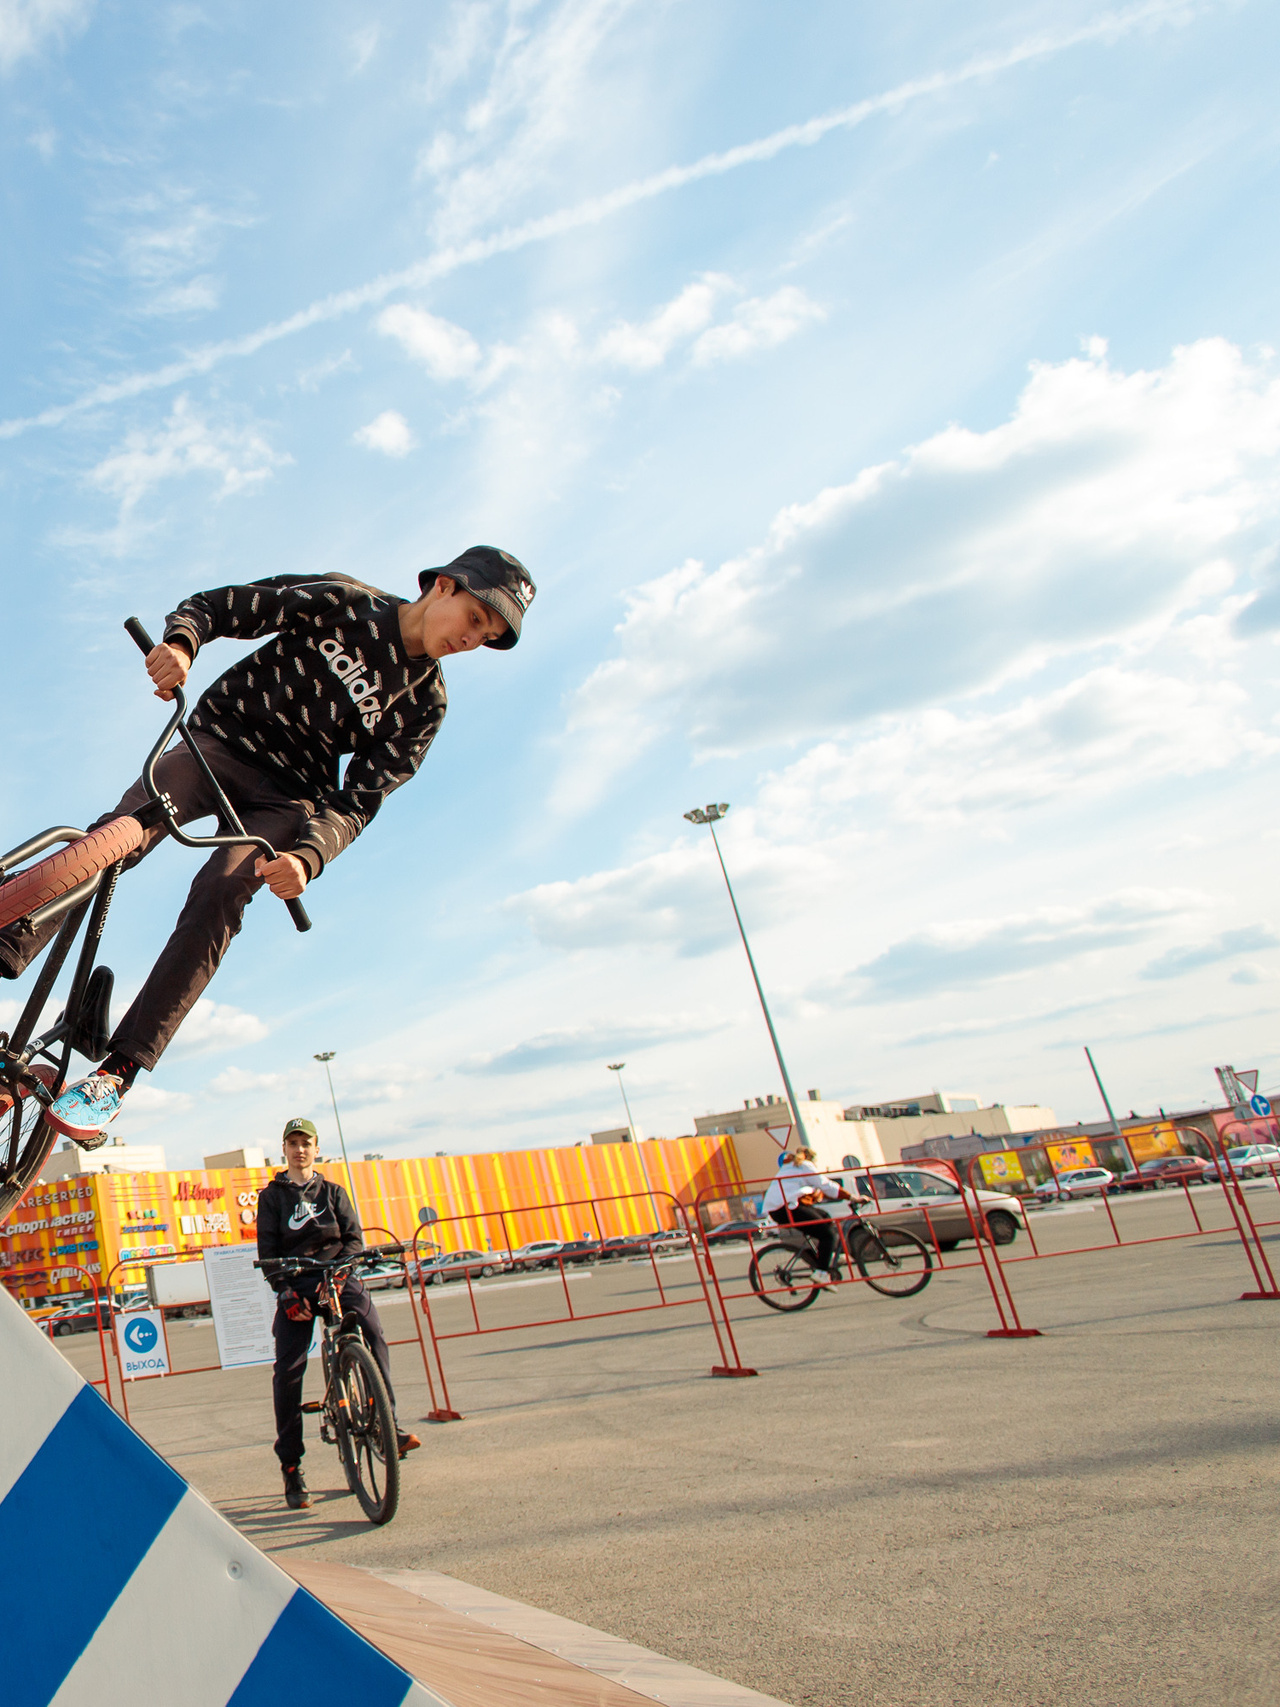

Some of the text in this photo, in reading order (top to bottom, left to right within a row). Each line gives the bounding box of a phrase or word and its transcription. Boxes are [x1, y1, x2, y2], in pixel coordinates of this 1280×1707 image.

[319, 639, 382, 728] adidas
[28, 1187, 93, 1207] RESERVED
[294, 1201, 318, 1219] NIKE
[57, 1225, 93, 1237] ГИПЕР
[13, 1247, 45, 1263] KFC
[126, 1358, 165, 1371] ВЫХОД
